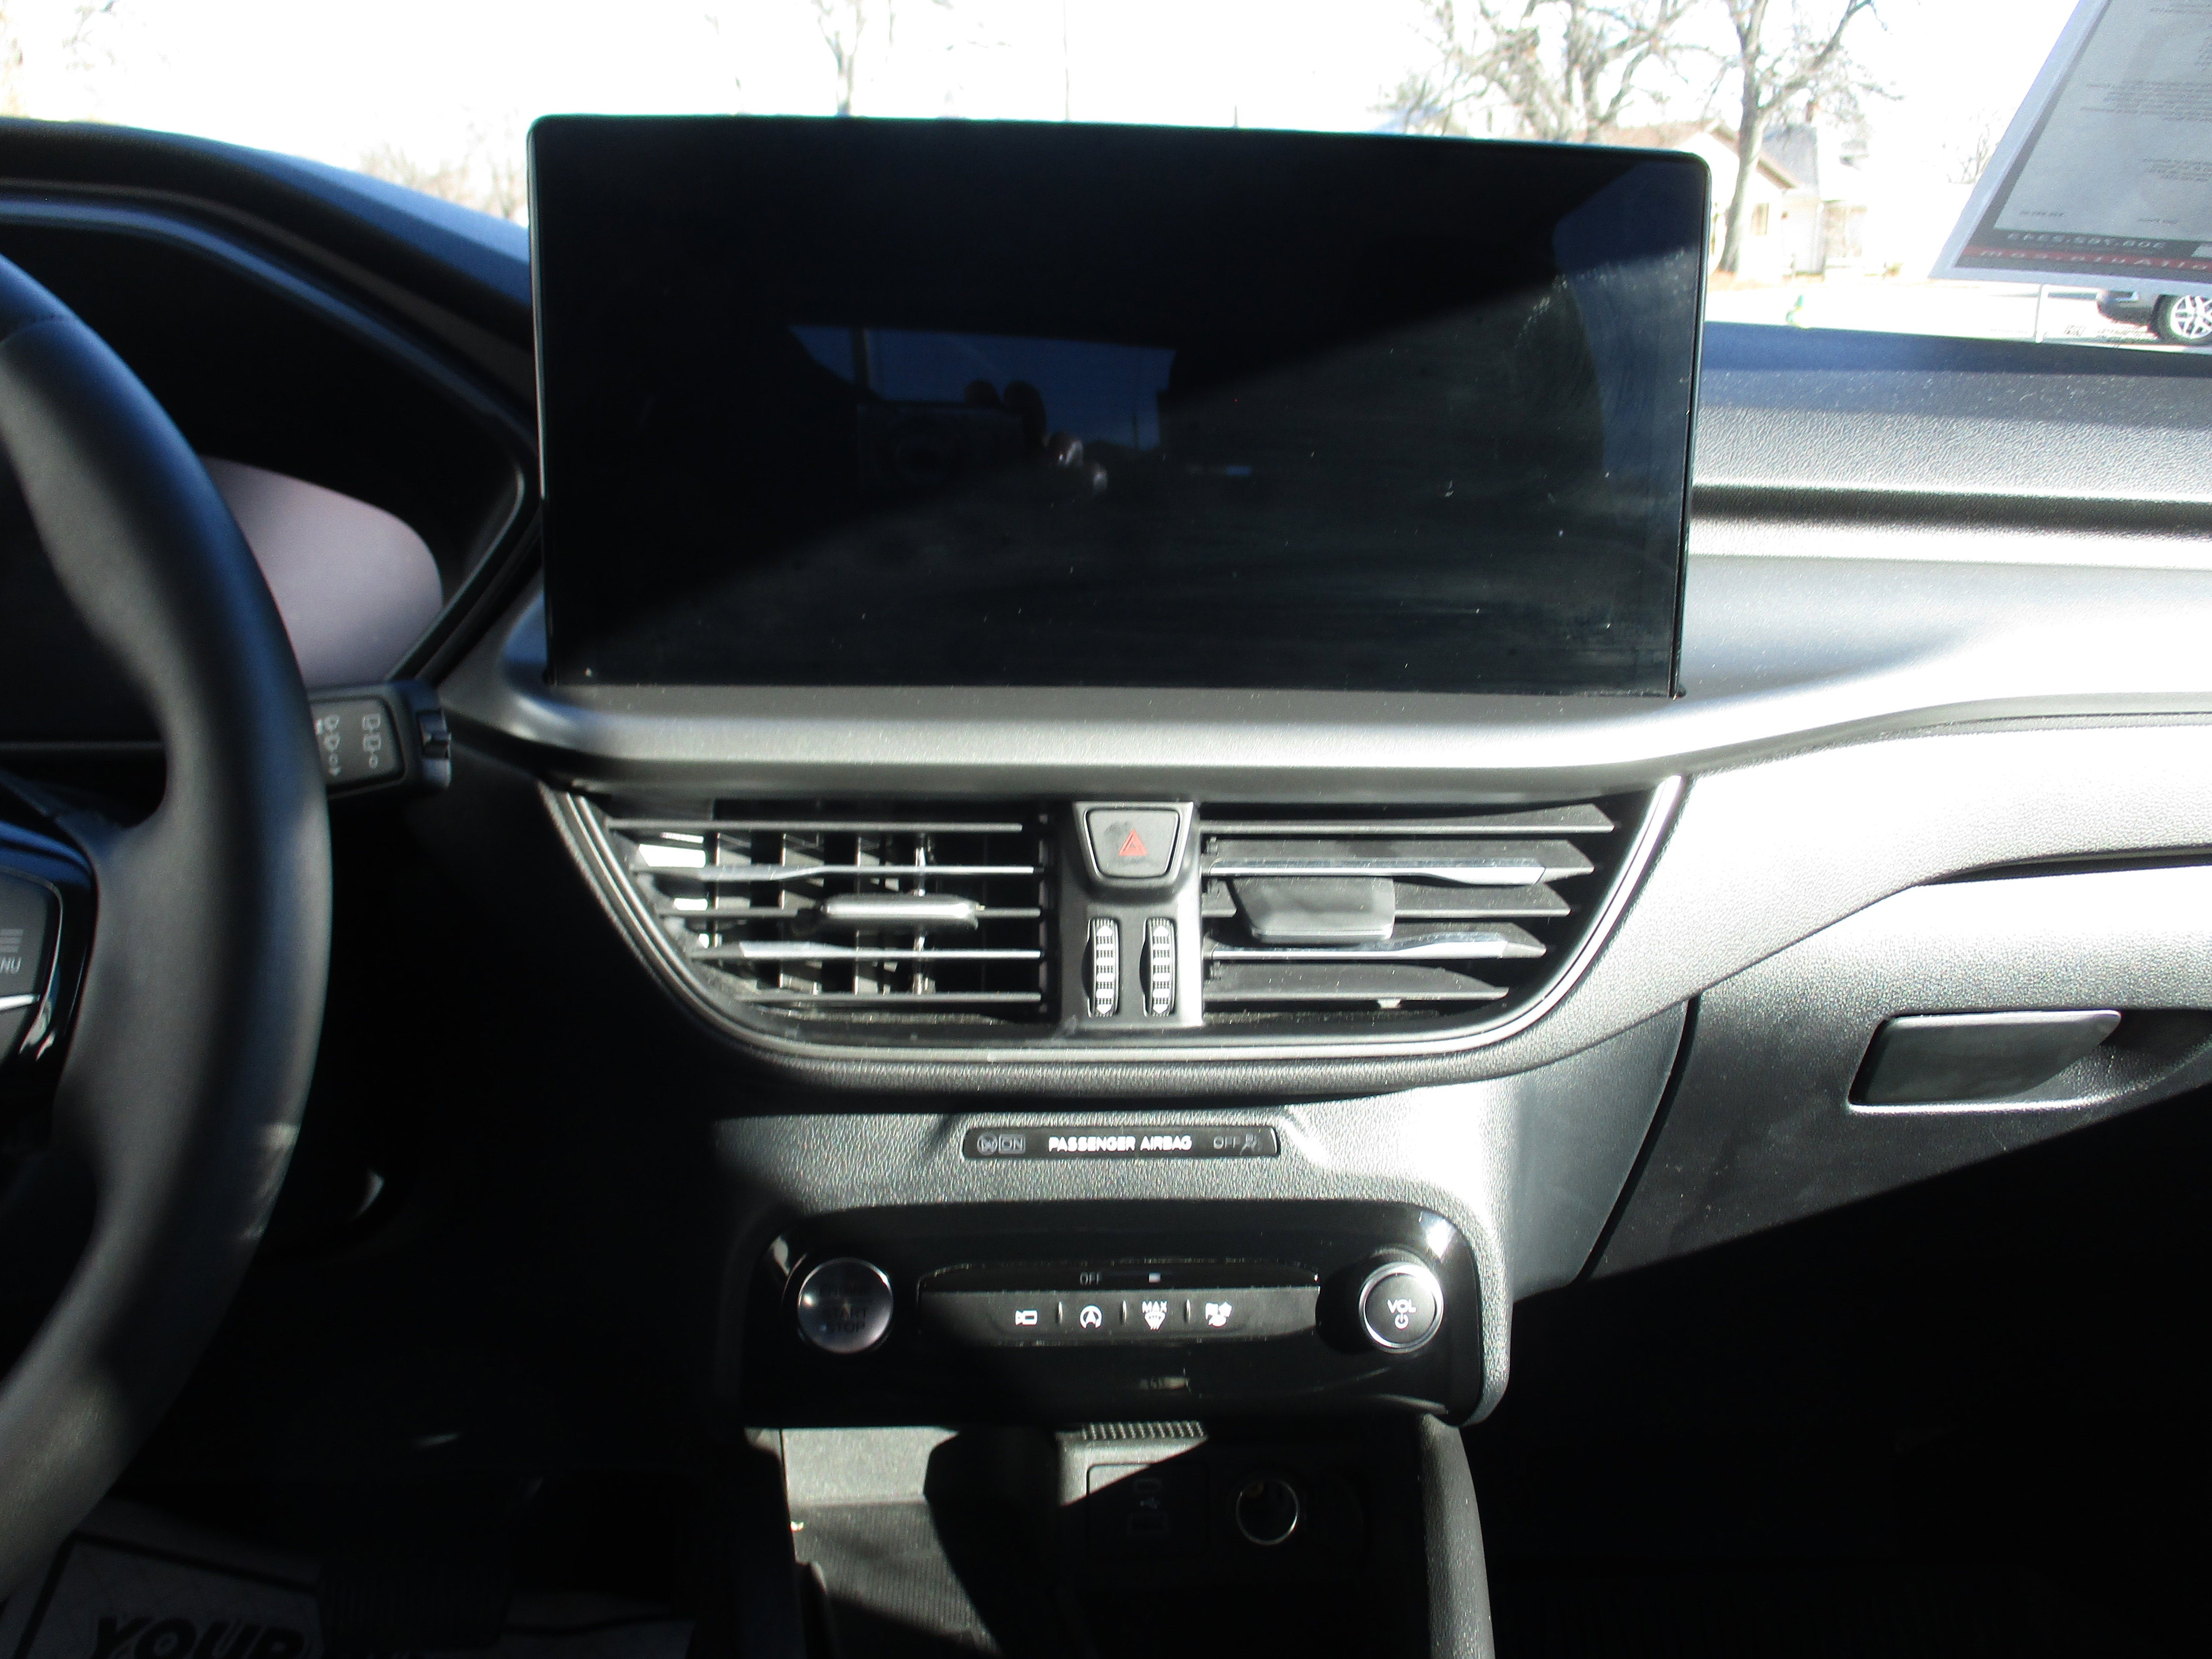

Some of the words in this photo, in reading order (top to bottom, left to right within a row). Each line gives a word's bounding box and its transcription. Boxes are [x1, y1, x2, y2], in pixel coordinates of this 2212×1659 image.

[1048, 1136, 1136, 1152] PASSENGER
[1140, 1135, 1192, 1151] AIRBAG
[1213, 1136, 1240, 1150] OFF
[1079, 1271, 1103, 1286] OFF
[1142, 1300, 1167, 1313] MAX
[1387, 1299, 1416, 1313] VOL
